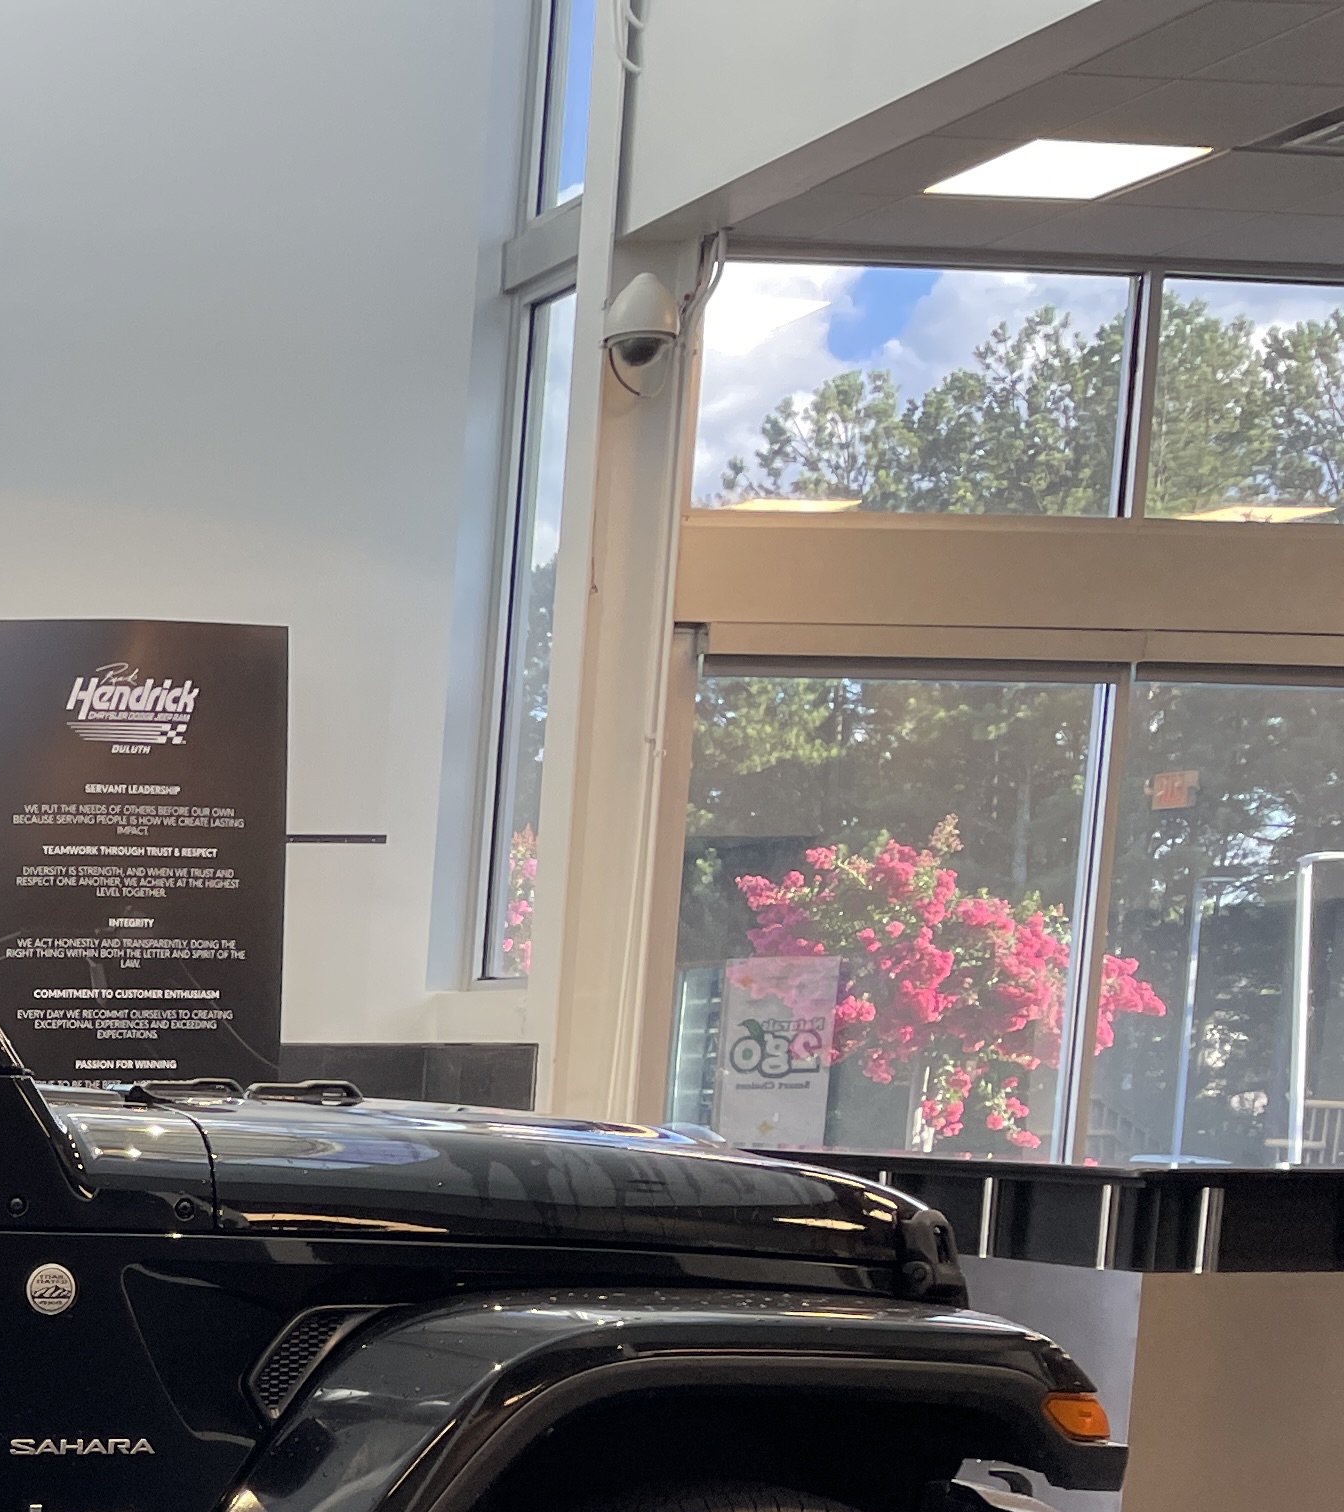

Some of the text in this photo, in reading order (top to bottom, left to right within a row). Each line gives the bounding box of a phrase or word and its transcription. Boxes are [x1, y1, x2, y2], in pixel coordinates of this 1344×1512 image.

[65, 677, 200, 720] Hendrick
[88, 711, 128, 720] CHRYSLER
[172, 713, 191, 722] RAM
[111, 744, 151, 754] DULUTH
[85, 784, 180, 795] SERVANT LEADERSHIP
[24, 805, 234, 817] WE PUT THE NEEDS OF OTHERS BEFORE OUR OWN
[13, 815, 245, 828] BECAUSE SERVING PEOPLE IS HOW WE CREATE LASTING
[43, 846, 217, 857] TEAMWORK THROUGH TRUST & RESPECT
[23, 866, 67, 876] DIVERSITY
[69, 867, 76, 876] IS
[126, 867, 145, 877] AND
[147, 868, 174, 877] WHEN
[175, 868, 188, 877] WE
[191, 868, 214, 878] TRUST
[216, 869, 234, 878] AND
[16, 877, 55, 886] RESPECT
[57, 877, 77, 886] ONE
[123, 878, 138, 887] WE
[140, 878, 175, 888] ACHIEVE
[177, 879, 187, 888] AT
[189, 879, 203, 888] THE
[205, 879, 240, 889] HIGHEST
[97, 888, 120, 897] LEVEL
[109, 919, 154, 928] INTEGRITY
[17, 939, 32, 948] WE
[35, 939, 52, 948] ACT
[54, 939, 99, 948] HONESTLY
[102, 939, 121, 948] AND
[191, 940, 219, 949] DOING
[221, 940, 236, 949] THE
[6, 949, 245, 959] RIGHT THING WITHIN BOTH THE LETTER AND SPIRIT OF THE
[34, 989, 220, 999] COMMITMENT TO CUSTOMER ENTHUSIASM
[17, 1010, 233, 1019] EVERY DAY WE RECOMMIT OURSELVES TO CREATING
[35, 1020, 217, 1029] EXCEPTIONAL EXPERIENCES AND EXCEEDING
[75, 1060, 177, 1069] PASSION FOR WINNING
[10, 1438, 155, 1455] SAHARA
